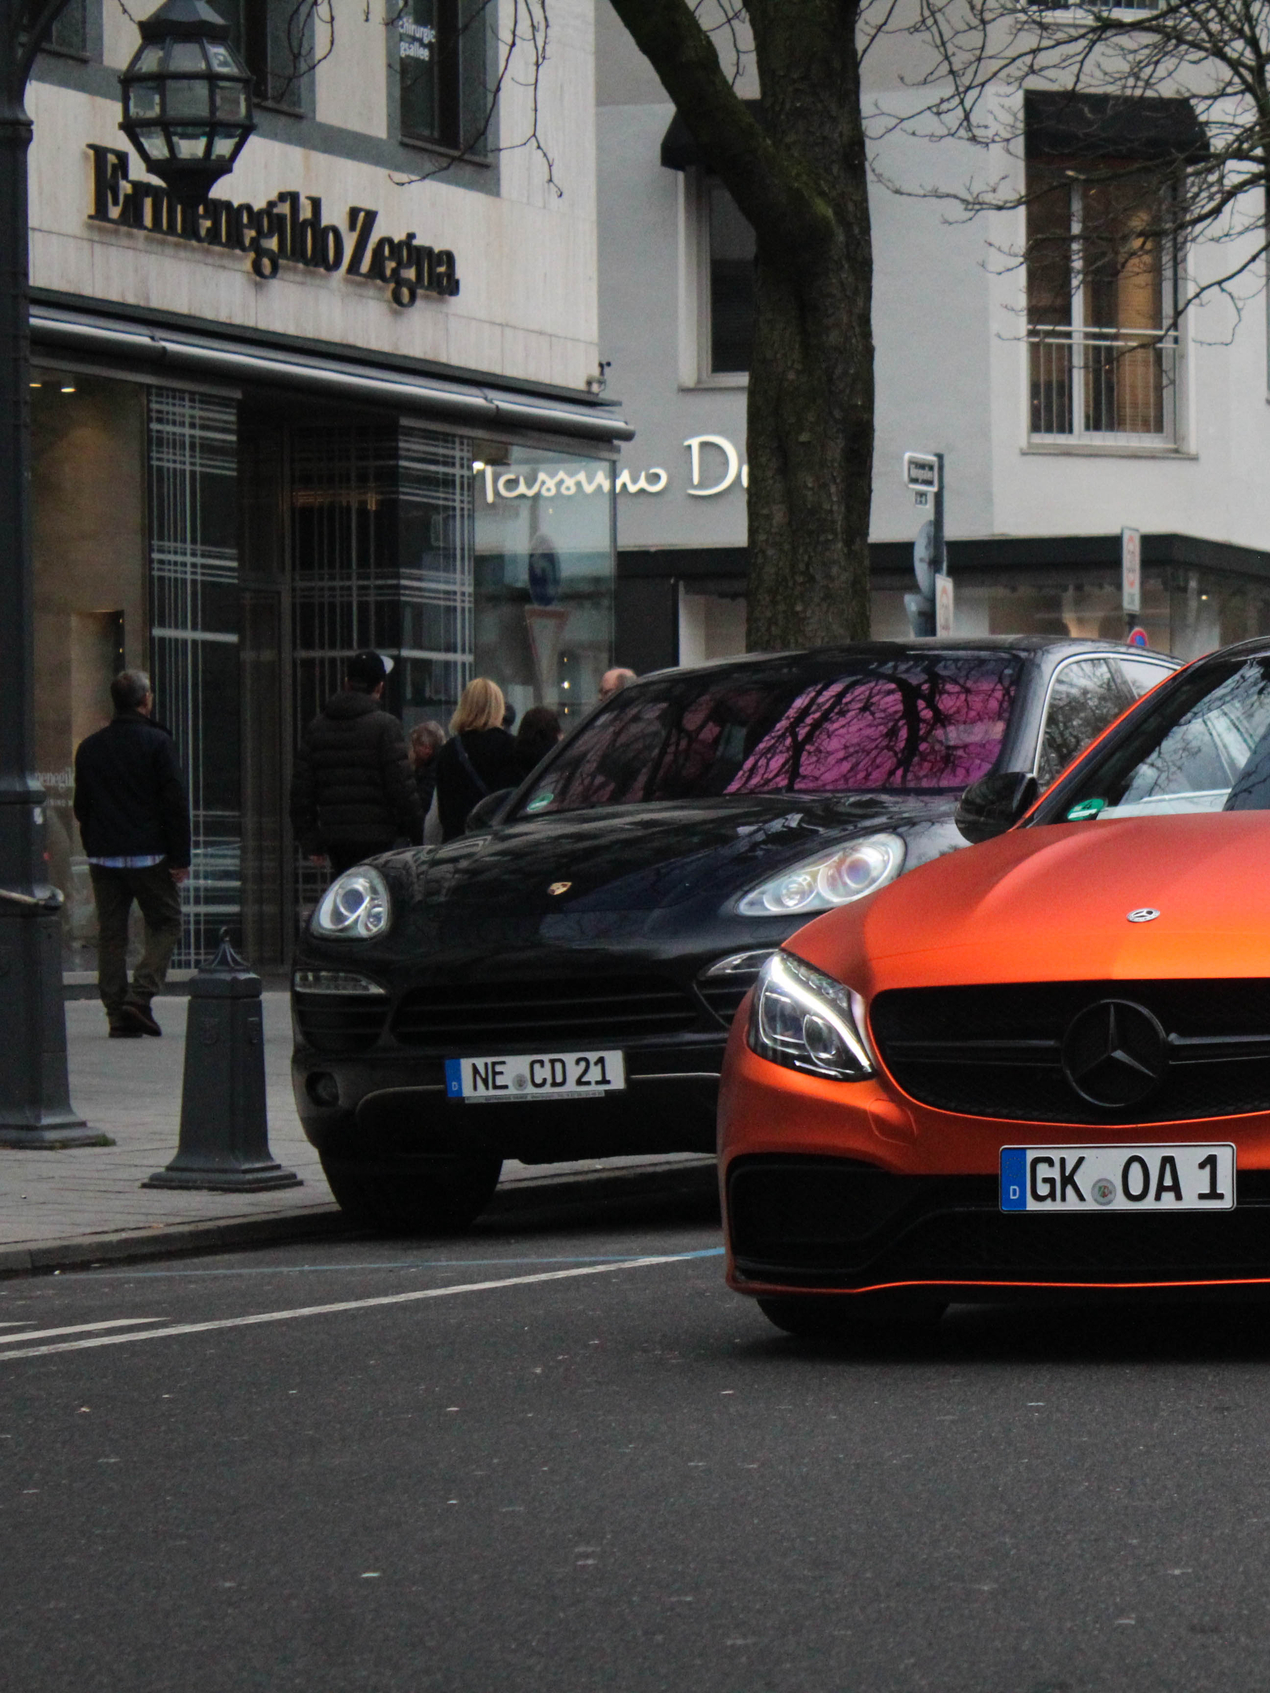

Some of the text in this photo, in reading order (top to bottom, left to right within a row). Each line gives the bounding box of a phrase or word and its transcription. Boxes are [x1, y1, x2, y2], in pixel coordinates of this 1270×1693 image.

[86, 143, 344, 280] Ermenegildo
[471, 1060, 510, 1092] NE
[529, 1057, 568, 1089] CD
[574, 1055, 612, 1086] 21
[1009, 1153, 1226, 1204] D GK OA 1
